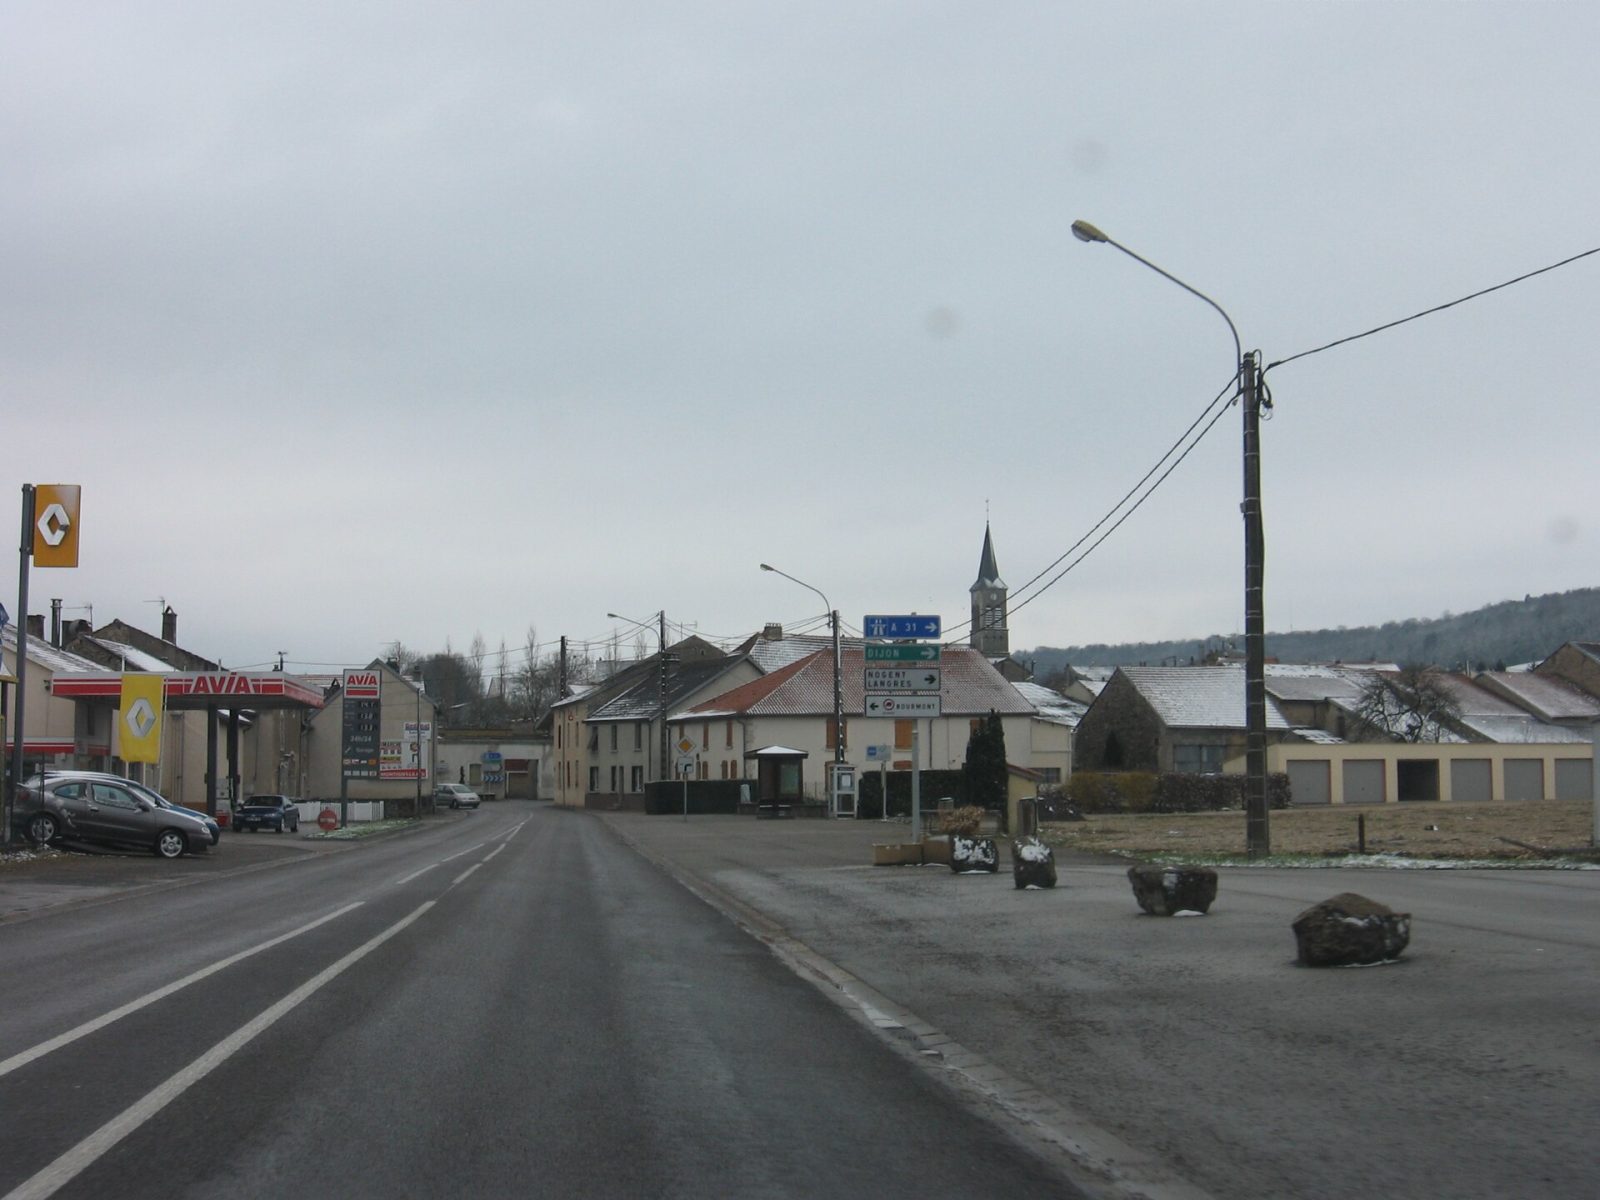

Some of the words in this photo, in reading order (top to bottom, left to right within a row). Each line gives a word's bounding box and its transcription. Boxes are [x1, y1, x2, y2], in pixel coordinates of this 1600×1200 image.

[890, 622, 898, 632] A
[904, 622, 917, 632] 31
[867, 648, 900, 659] DIJON
[346, 672, 378, 686] AVIA
[867, 671, 907, 679] NOGENT
[192, 671, 254, 694] AVIA
[867, 680, 913, 688] LANGRES
